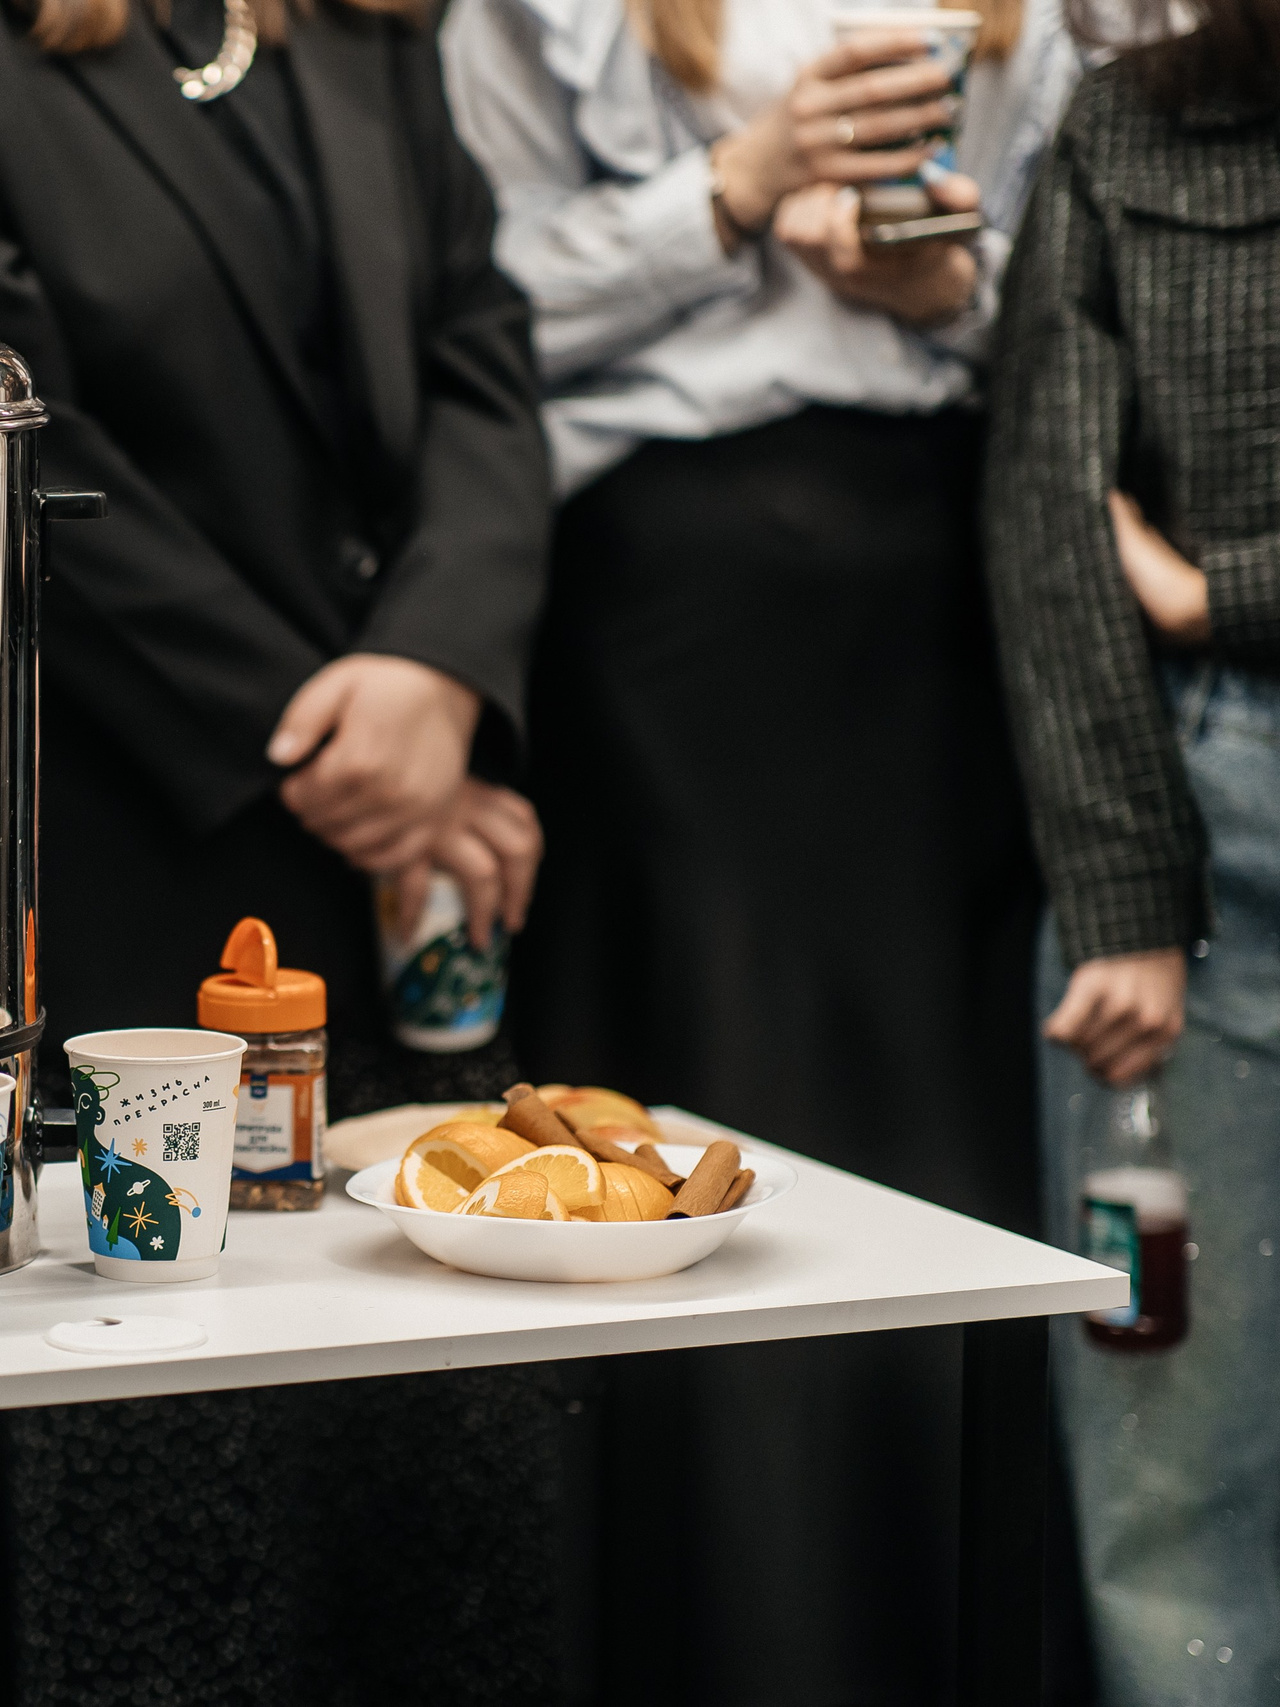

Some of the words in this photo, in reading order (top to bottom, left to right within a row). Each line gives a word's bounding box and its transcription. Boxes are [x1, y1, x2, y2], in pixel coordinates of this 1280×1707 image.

[113, 1075, 210, 1126] ПРЕКРАСНА
[120, 1079, 182, 1107] ЖИЗНЬ
[202, 1100, 213, 1109] 300
[213, 1099, 221, 1107] ml
